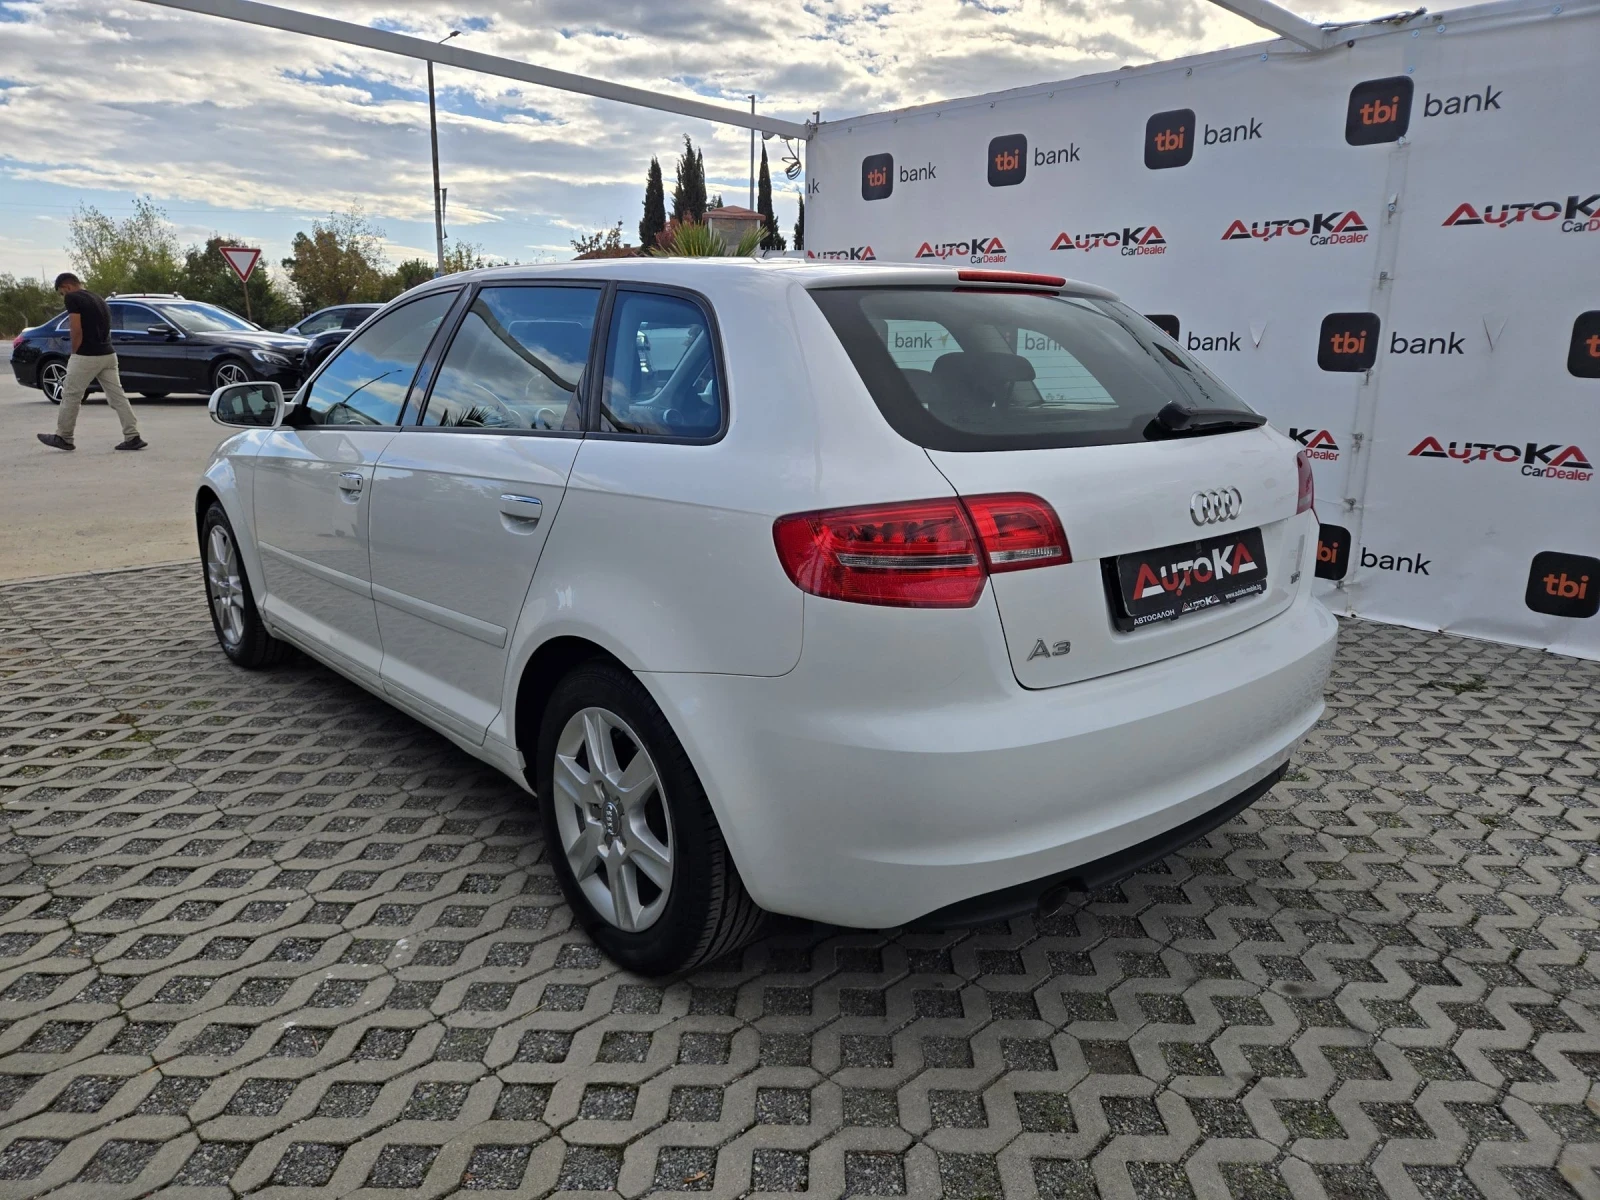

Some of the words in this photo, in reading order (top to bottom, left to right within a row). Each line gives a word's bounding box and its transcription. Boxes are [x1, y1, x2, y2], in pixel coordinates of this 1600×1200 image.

[1360, 96, 1398, 125] tbi
[1423, 85, 1503, 117] bank
[1154, 126, 1184, 151] tbi
[1204, 118, 1263, 145] bank
[995, 148, 1019, 171] tbi
[1035, 143, 1080, 166] bank
[867, 167, 886, 187] tbi
[899, 162, 936, 183] bank
[1121, 244, 1166, 257] CarDealer
[1310, 232, 1368, 246] CarDealer
[894, 333, 932, 348] bank
[1025, 333, 1061, 351] ban
[1187, 331, 1242, 352] bank
[1330, 331, 1366, 354] tbi
[1389, 331, 1466, 355] bank
[1521, 464, 1593, 482] CarDealer
[1317, 541, 1338, 563] bi
[1360, 547, 1432, 576] bank
[1543, 573, 1589, 600] tbi
[1134, 609, 1175, 625] АВТОСАЛОН
[1026, 638, 1071, 661] A3
